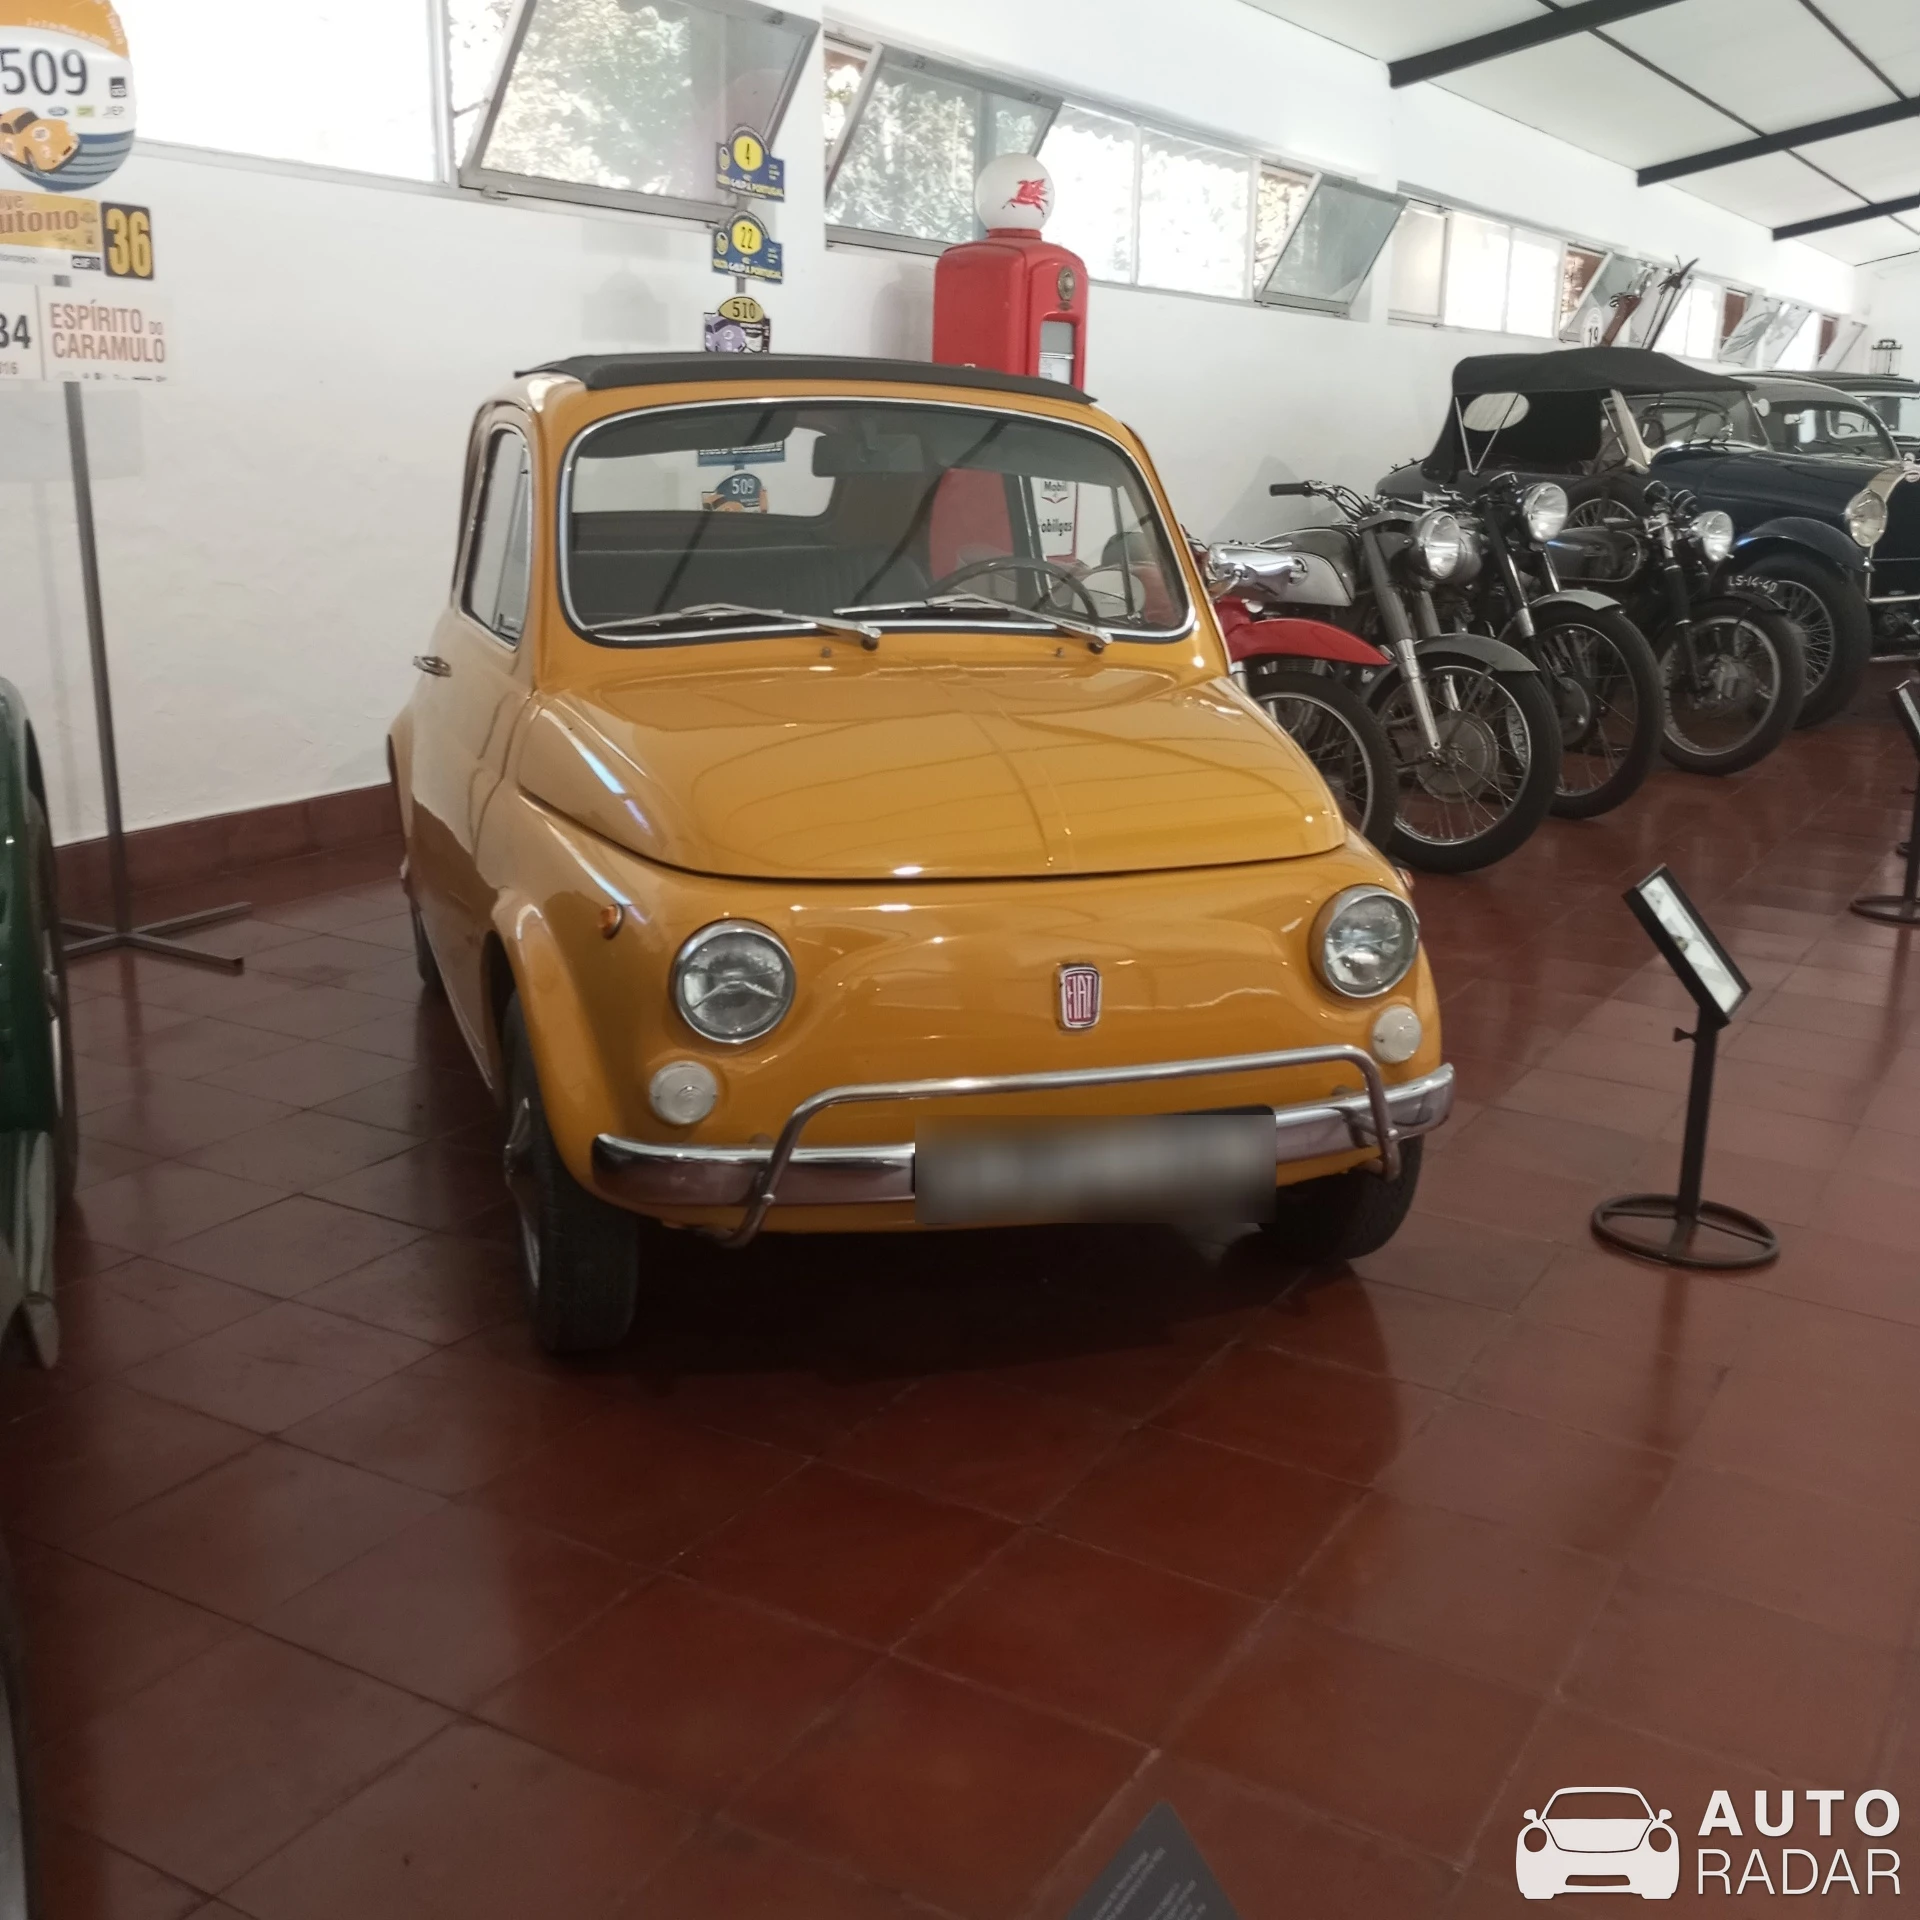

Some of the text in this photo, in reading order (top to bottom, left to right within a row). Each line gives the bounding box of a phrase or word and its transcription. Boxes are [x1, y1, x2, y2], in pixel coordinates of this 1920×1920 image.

[0, 47, 87, 96] 509
[106, 208, 151, 277] 36
[50, 299, 143, 334] ESPÍRITO
[732, 301, 756, 319] 510
[52, 332, 166, 363] CARAMULO
[732, 478, 755, 495] 509
[1044, 481, 1067, 491] Mobil
[1041, 519, 1072, 536] obilgas
[1066, 975, 1093, 1019] FIAT
